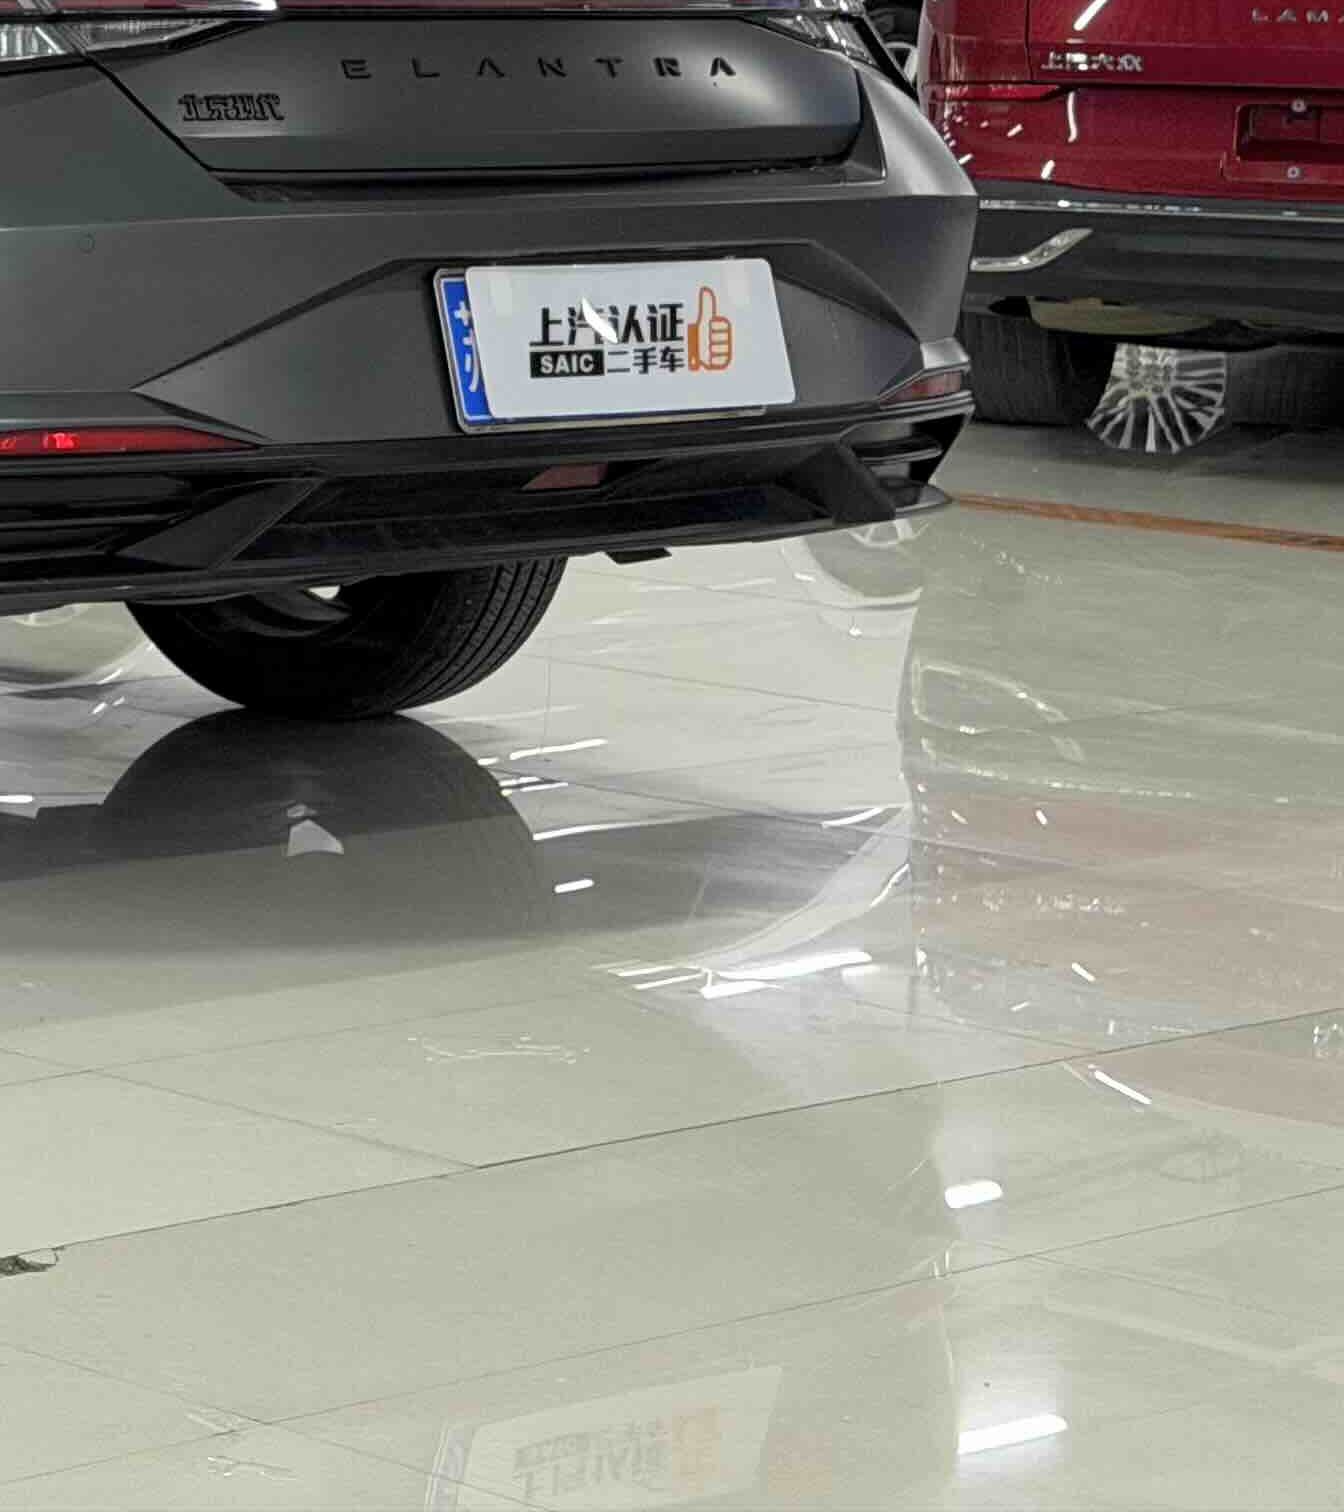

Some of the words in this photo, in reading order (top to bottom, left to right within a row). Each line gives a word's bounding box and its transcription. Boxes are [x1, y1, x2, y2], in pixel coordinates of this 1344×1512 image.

[341, 56, 737, 82] ELANTRA
[177, 93, 285, 122] 北京现代
[539, 351, 596, 375] SAIC
[606, 346, 686, 375] 二手车
